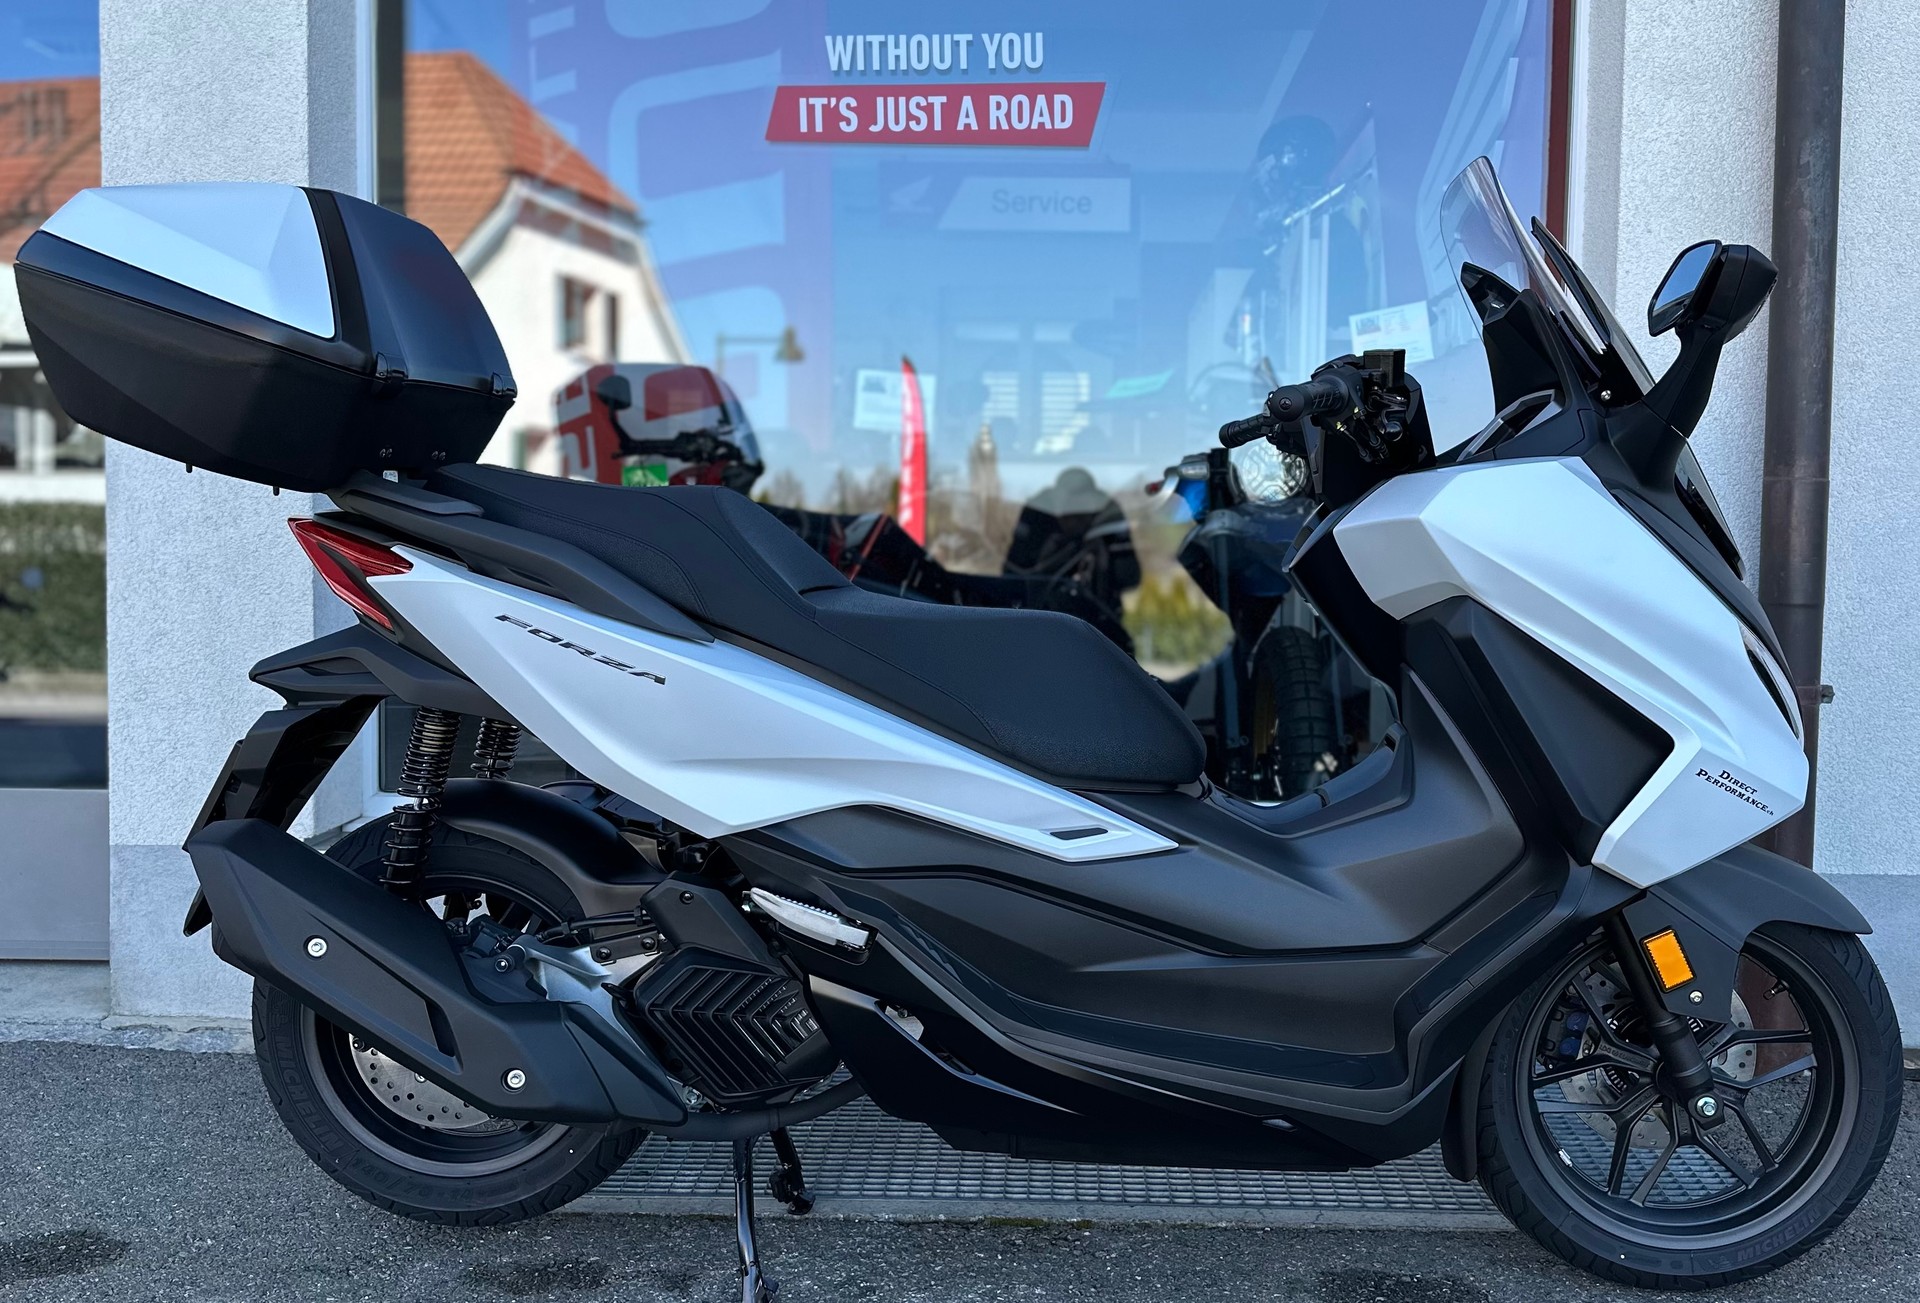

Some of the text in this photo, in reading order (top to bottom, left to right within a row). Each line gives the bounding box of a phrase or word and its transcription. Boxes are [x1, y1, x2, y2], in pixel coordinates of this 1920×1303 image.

[825, 32, 1044, 72] WITHOUT YOU
[799, 93, 1074, 133] IT'S JUST A ROAD
[991, 189, 1093, 215] Service
[494, 613, 666, 686] FORZA
[1718, 769, 1758, 795] DIRECT
[274, 1033, 345, 1152] MICHELIN
[1737, 1205, 1822, 1262] MICHELIN
